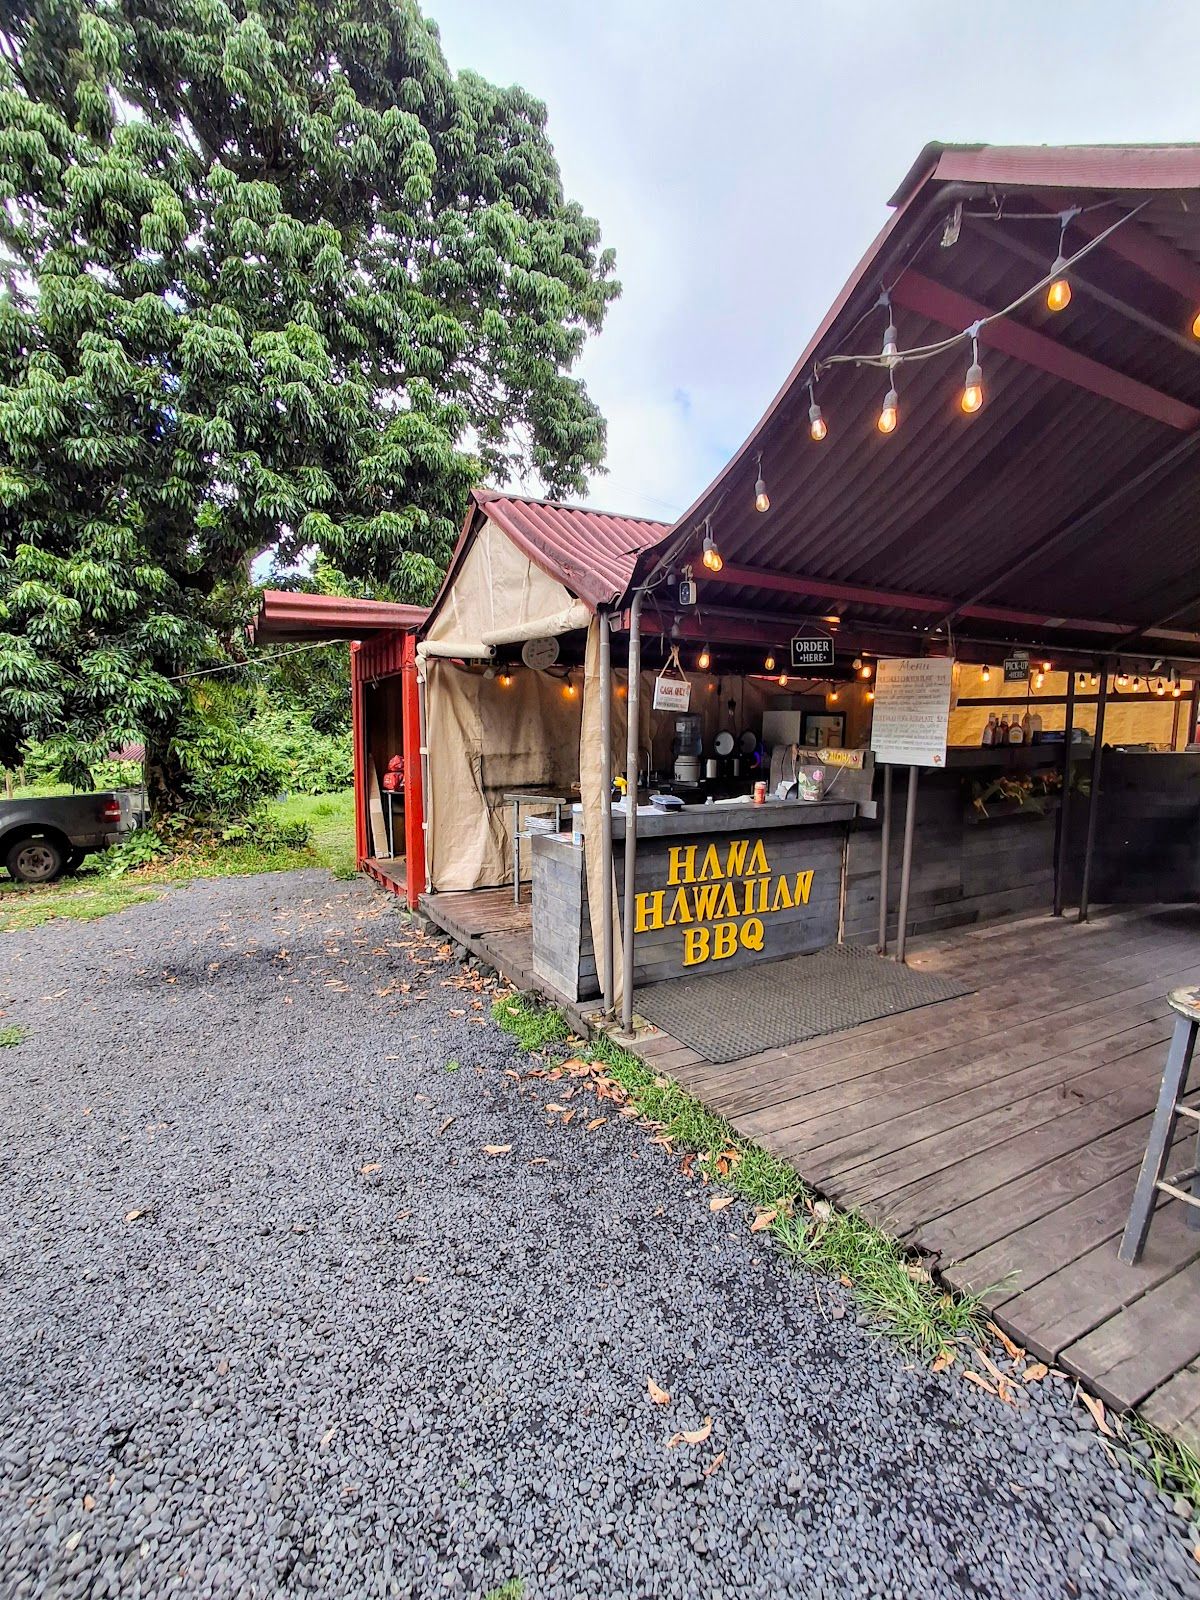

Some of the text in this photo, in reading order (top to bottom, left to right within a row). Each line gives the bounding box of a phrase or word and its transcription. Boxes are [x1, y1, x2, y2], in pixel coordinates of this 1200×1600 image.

[795, 641, 829, 652] ORDER
[803, 653, 824, 662] HERE
[898, 660, 930, 671] Menu
[1005, 661, 1028, 671] PICK-UP
[1010, 671, 1023, 679] HERE
[660, 686, 673, 696] CASH
[666, 839, 771, 886] HANA
[634, 870, 815, 934] HAWAIIAN
[682, 918, 765, 967] BBQ
